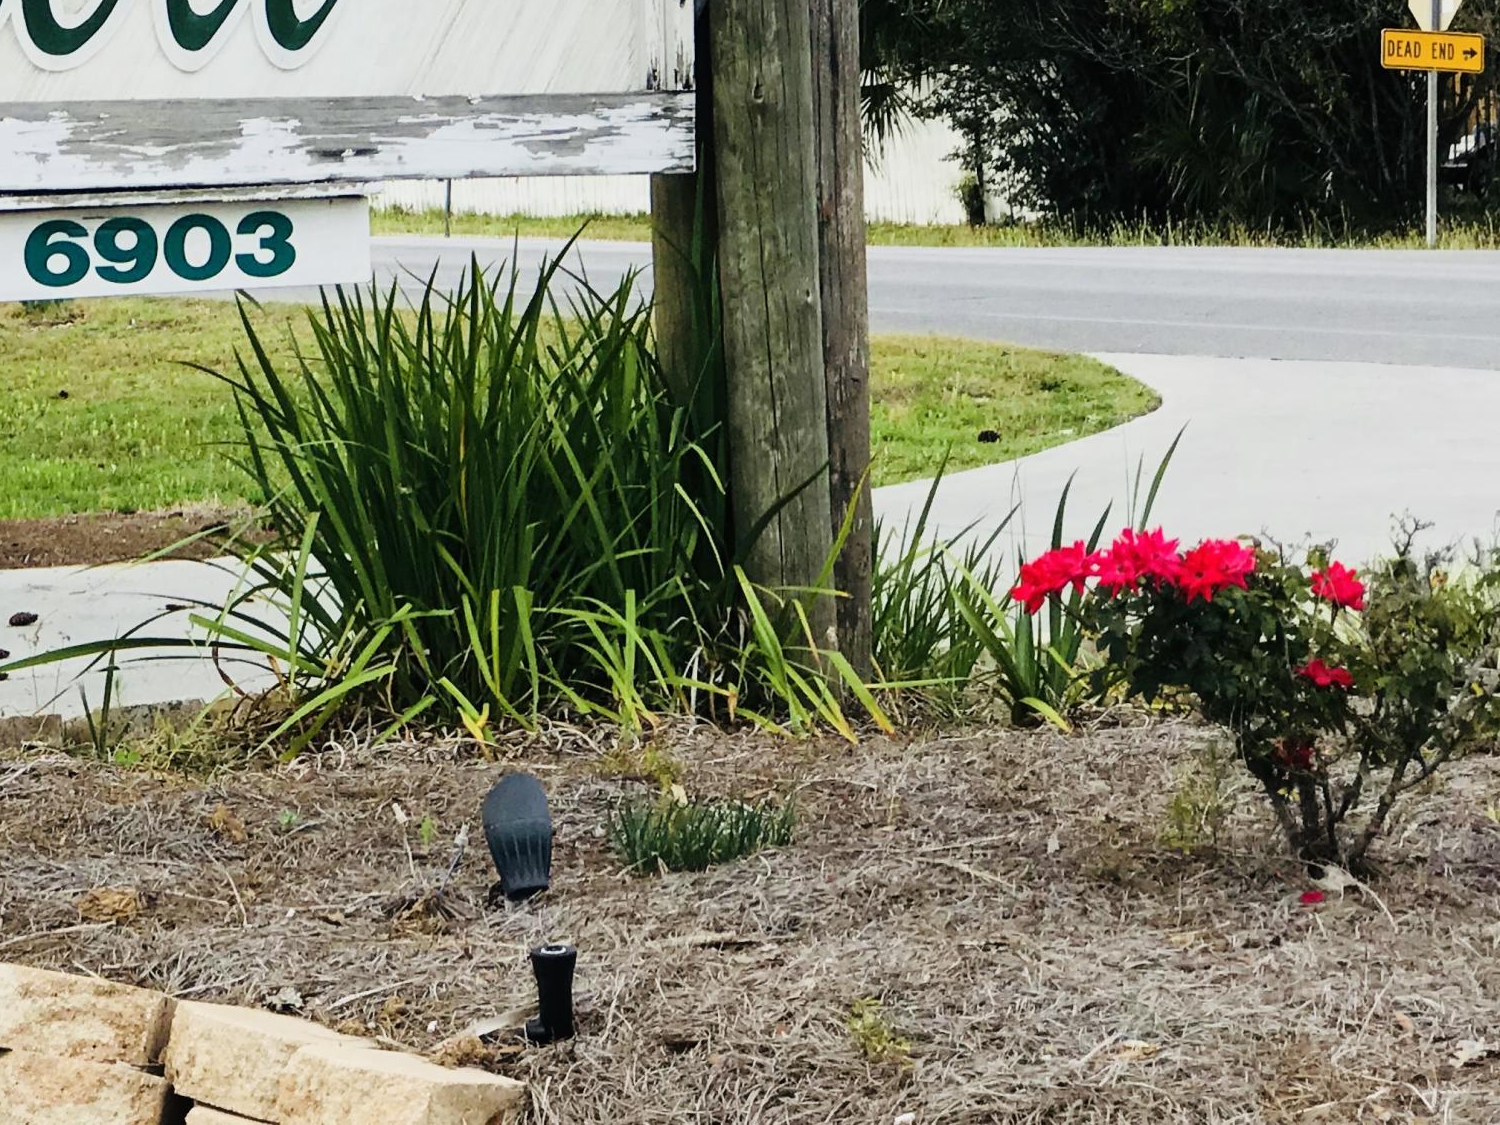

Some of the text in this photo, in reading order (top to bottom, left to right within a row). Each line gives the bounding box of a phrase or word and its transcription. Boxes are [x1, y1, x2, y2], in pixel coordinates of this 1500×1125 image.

[1387, 39, 1455, 60] DEAD END
[24, 211, 296, 287] 6903
